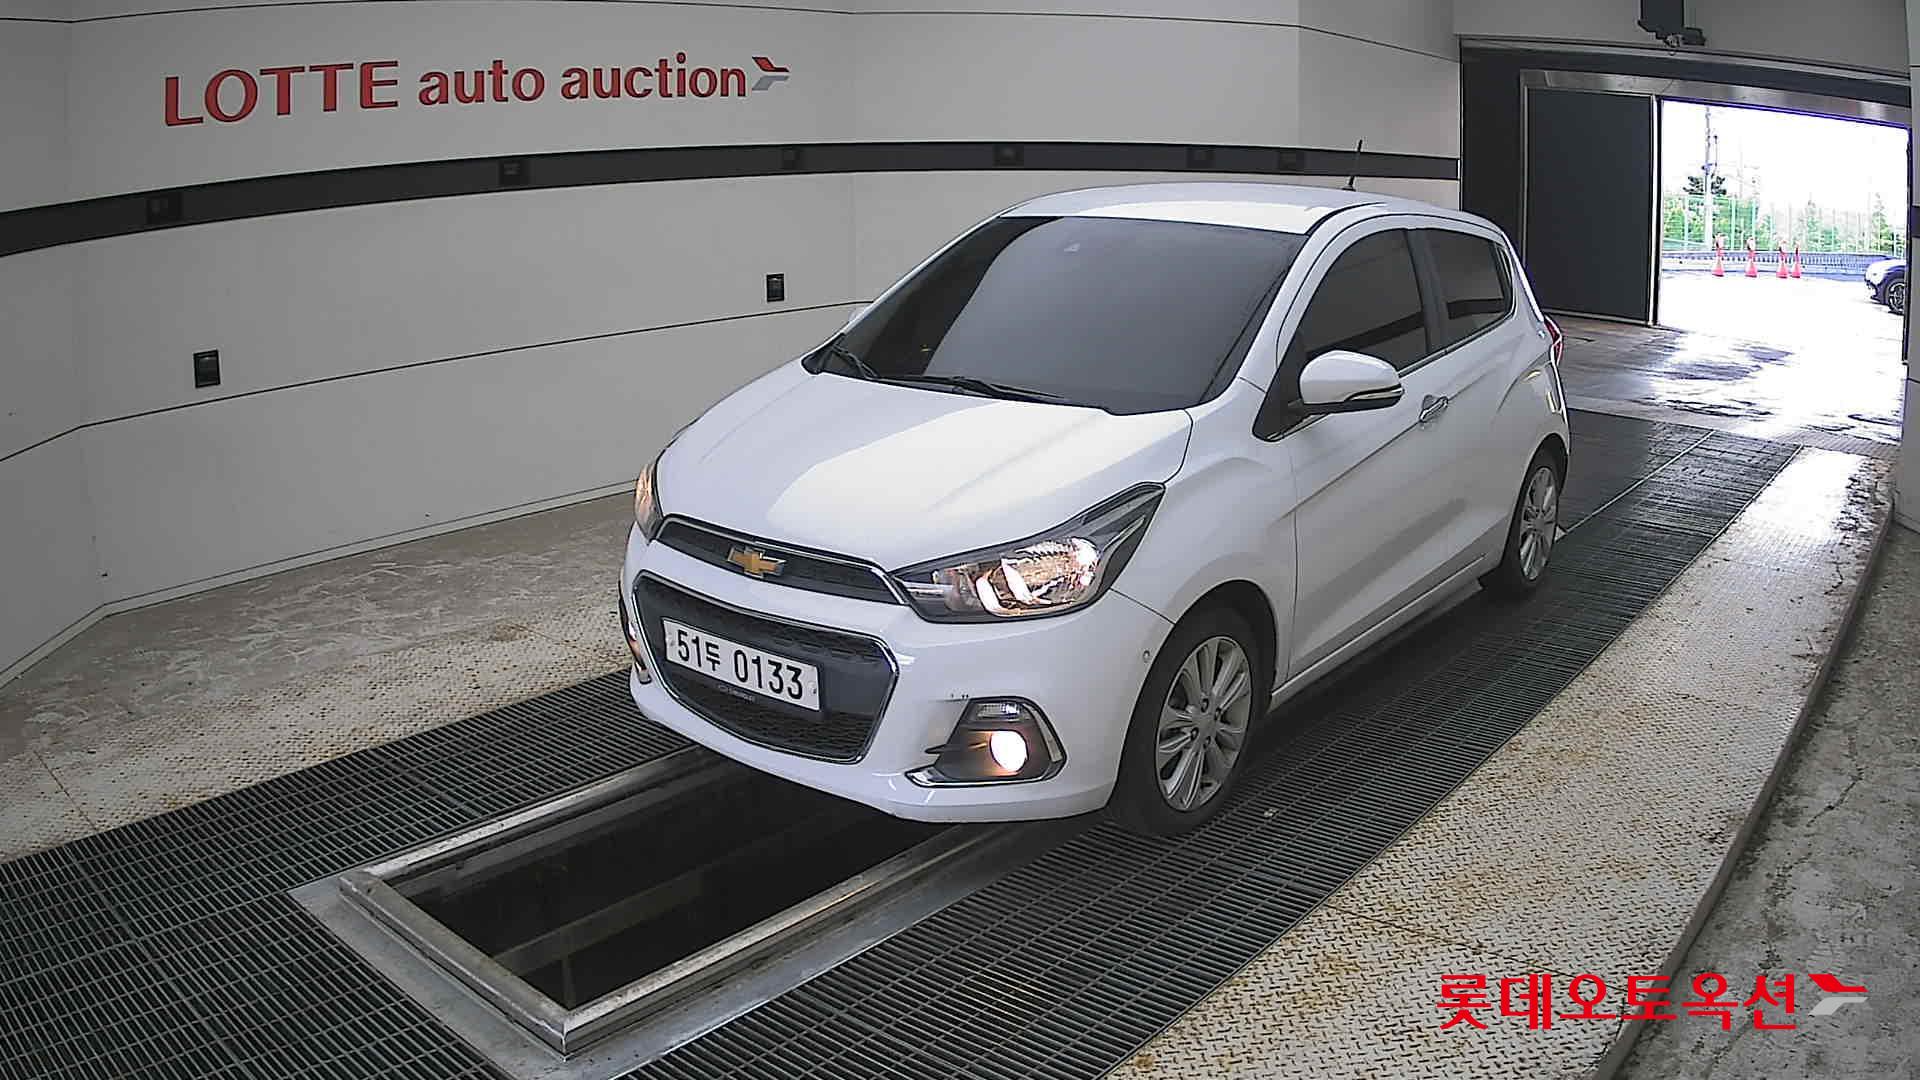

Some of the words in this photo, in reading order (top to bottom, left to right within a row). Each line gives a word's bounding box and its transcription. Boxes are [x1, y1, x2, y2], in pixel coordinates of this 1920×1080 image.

[164, 60, 399, 126] LOTTE
[418, 59, 546, 106] auto
[560, 53, 747, 98] auction
[677, 629, 721, 672] 51두
[733, 649, 803, 700] 0133
